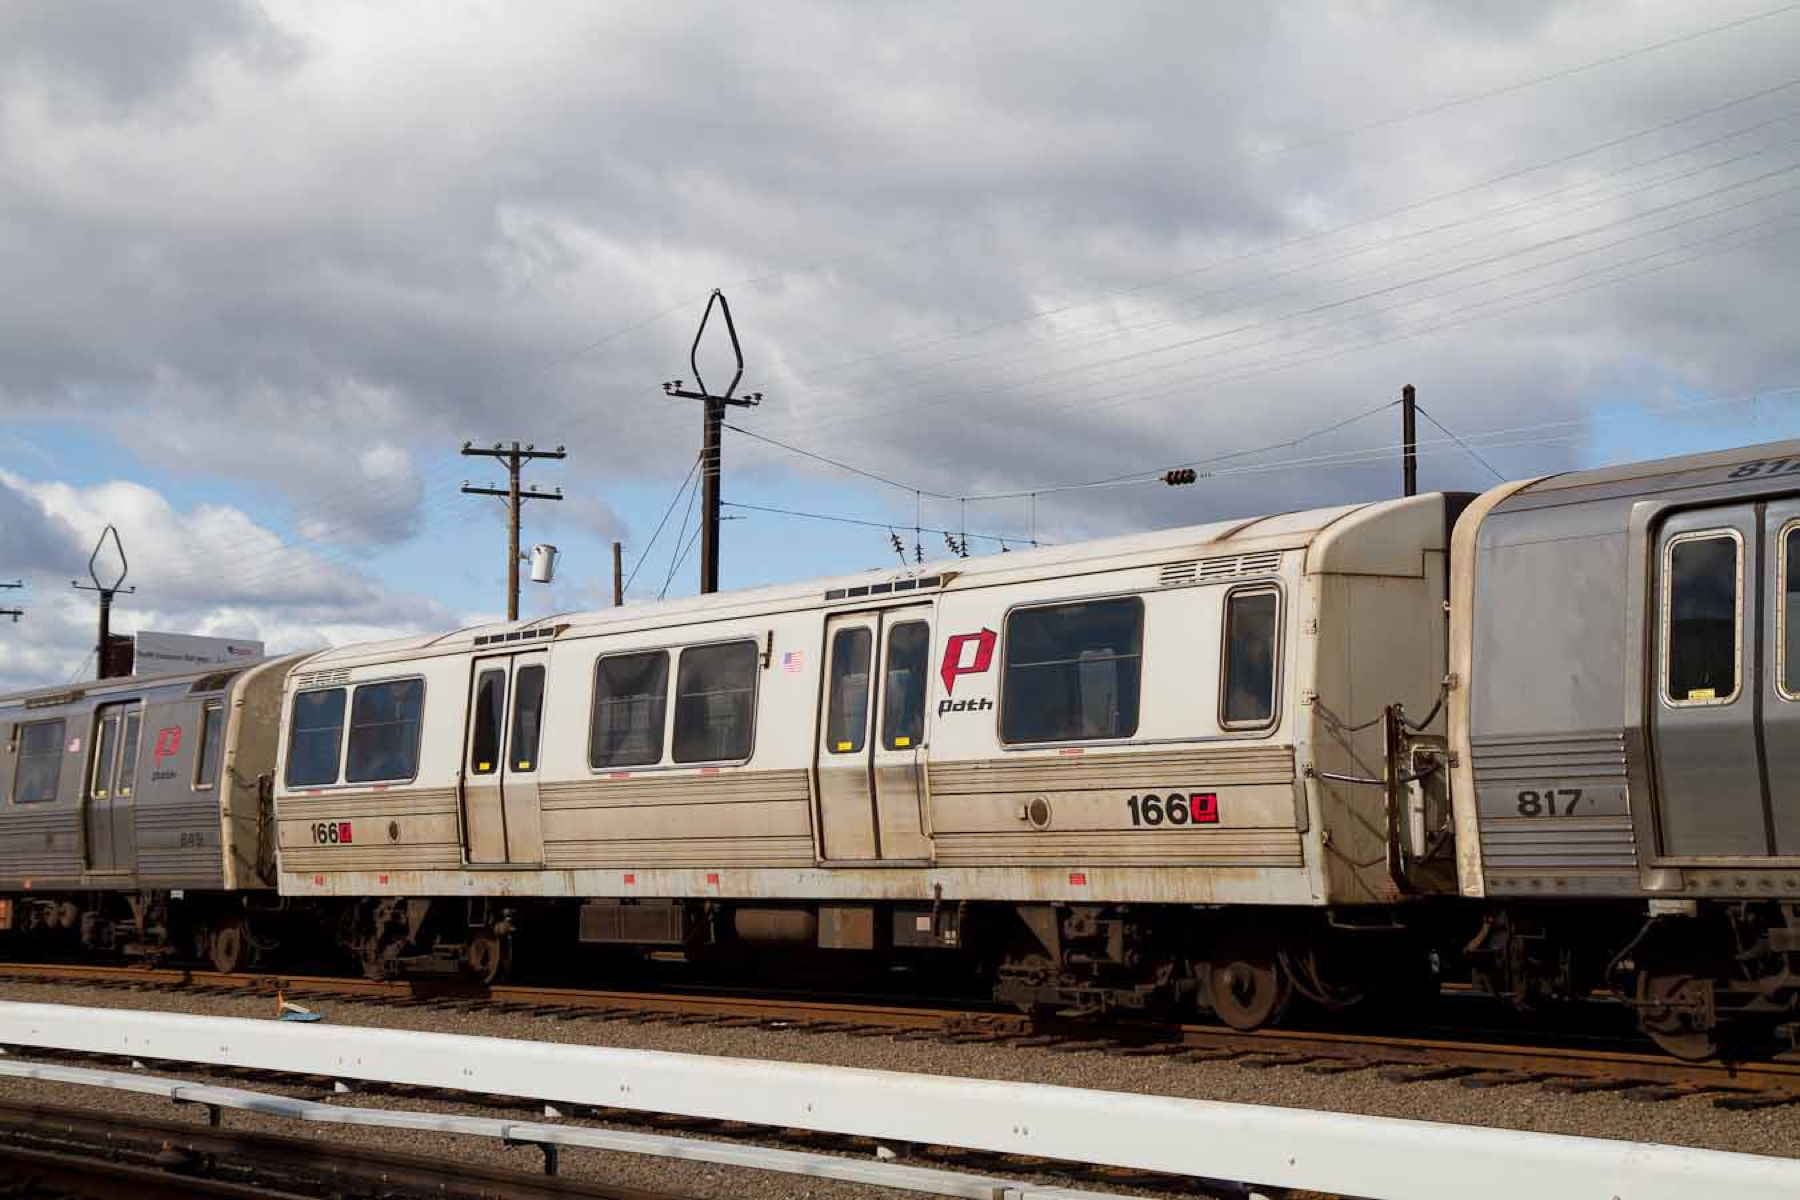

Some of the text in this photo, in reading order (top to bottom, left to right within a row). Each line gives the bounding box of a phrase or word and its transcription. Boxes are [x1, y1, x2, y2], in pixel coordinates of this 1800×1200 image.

[1127, 793, 1188, 825] 166
[1518, 789, 1583, 815] 817
[312, 822, 338, 844] 166
